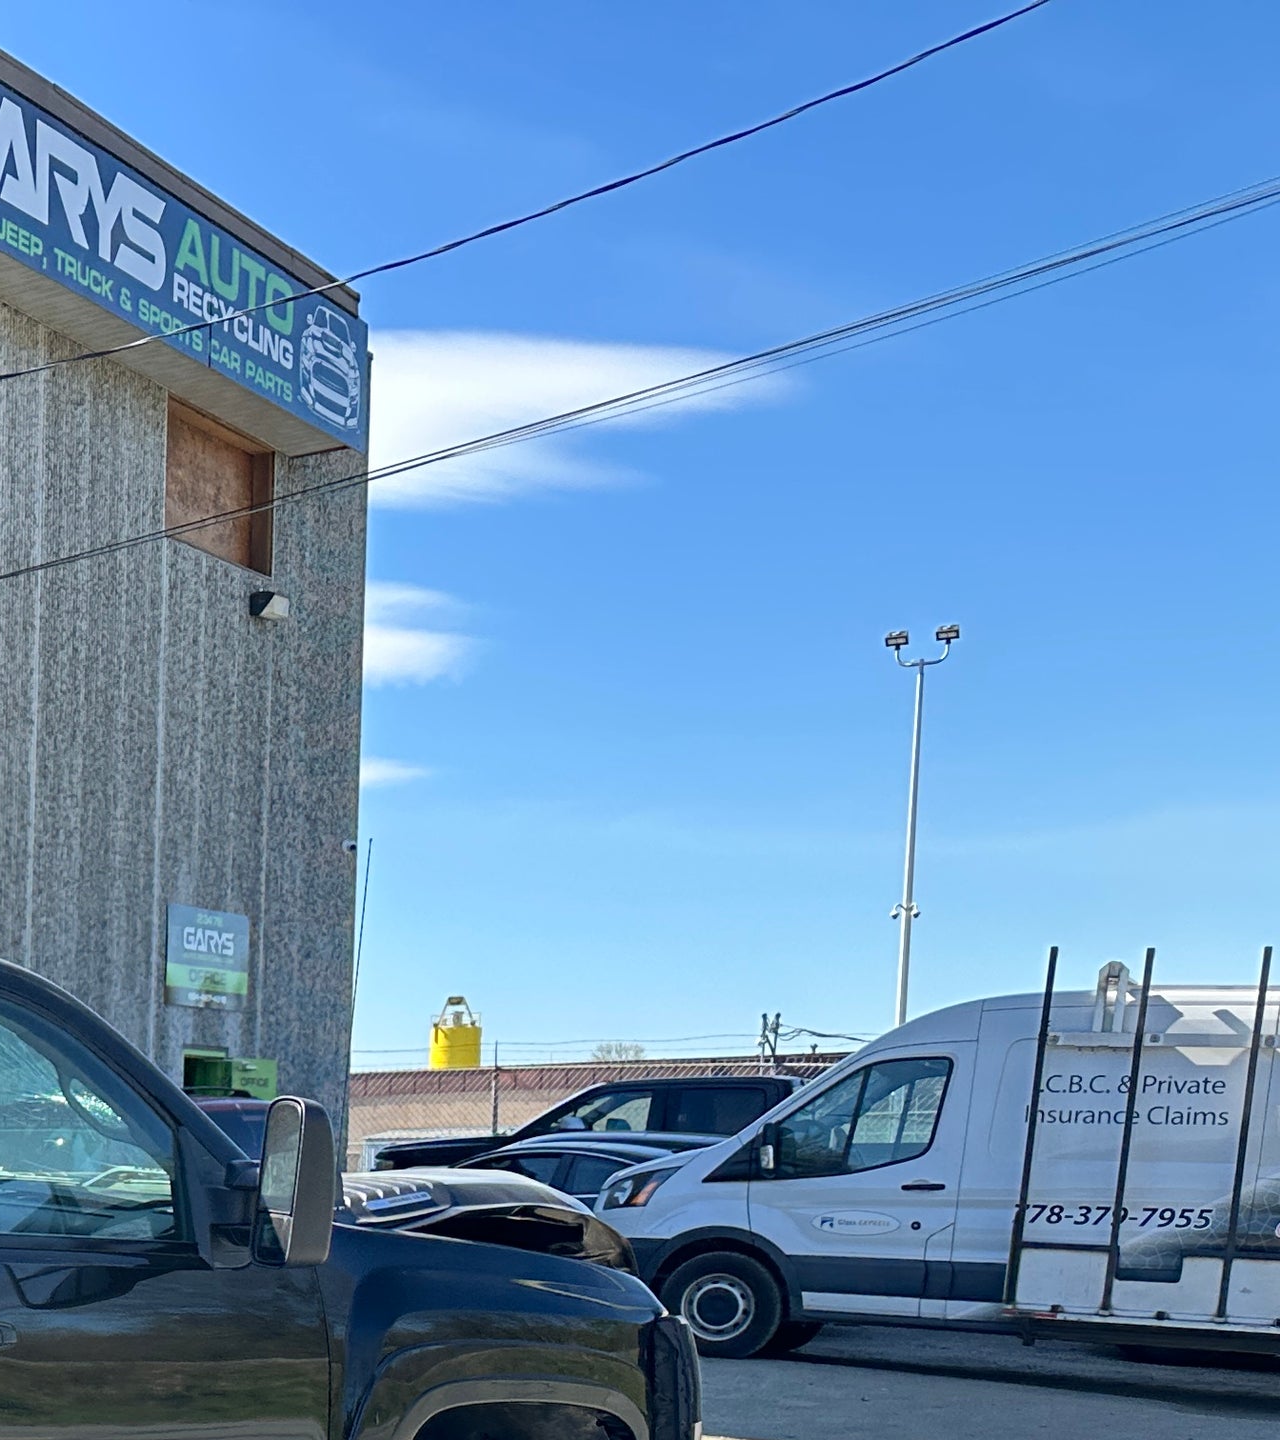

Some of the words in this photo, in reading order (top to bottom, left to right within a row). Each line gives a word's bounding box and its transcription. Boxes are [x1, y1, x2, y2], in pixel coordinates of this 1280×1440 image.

[175, 217, 294, 336] AUTO
[53, 247, 115, 302] TRUCK
[119, 287, 133, 313] &
[138, 297, 203, 352] SPORTS
[209, 338, 241, 374] CAR
[245, 358, 293, 403] PARTS
[173, 272, 294, 370] RECYCLING
[183, 926, 235, 957] GARYS
[1024, 1104, 1141, 1125] Insurance
[1147, 1105, 1230, 1126] Claims
[1036, 1074, 1111, 1094] .C.B.C.
[1117, 1074, 1133, 1094] &
[1142, 1074, 1227, 1095] Private
